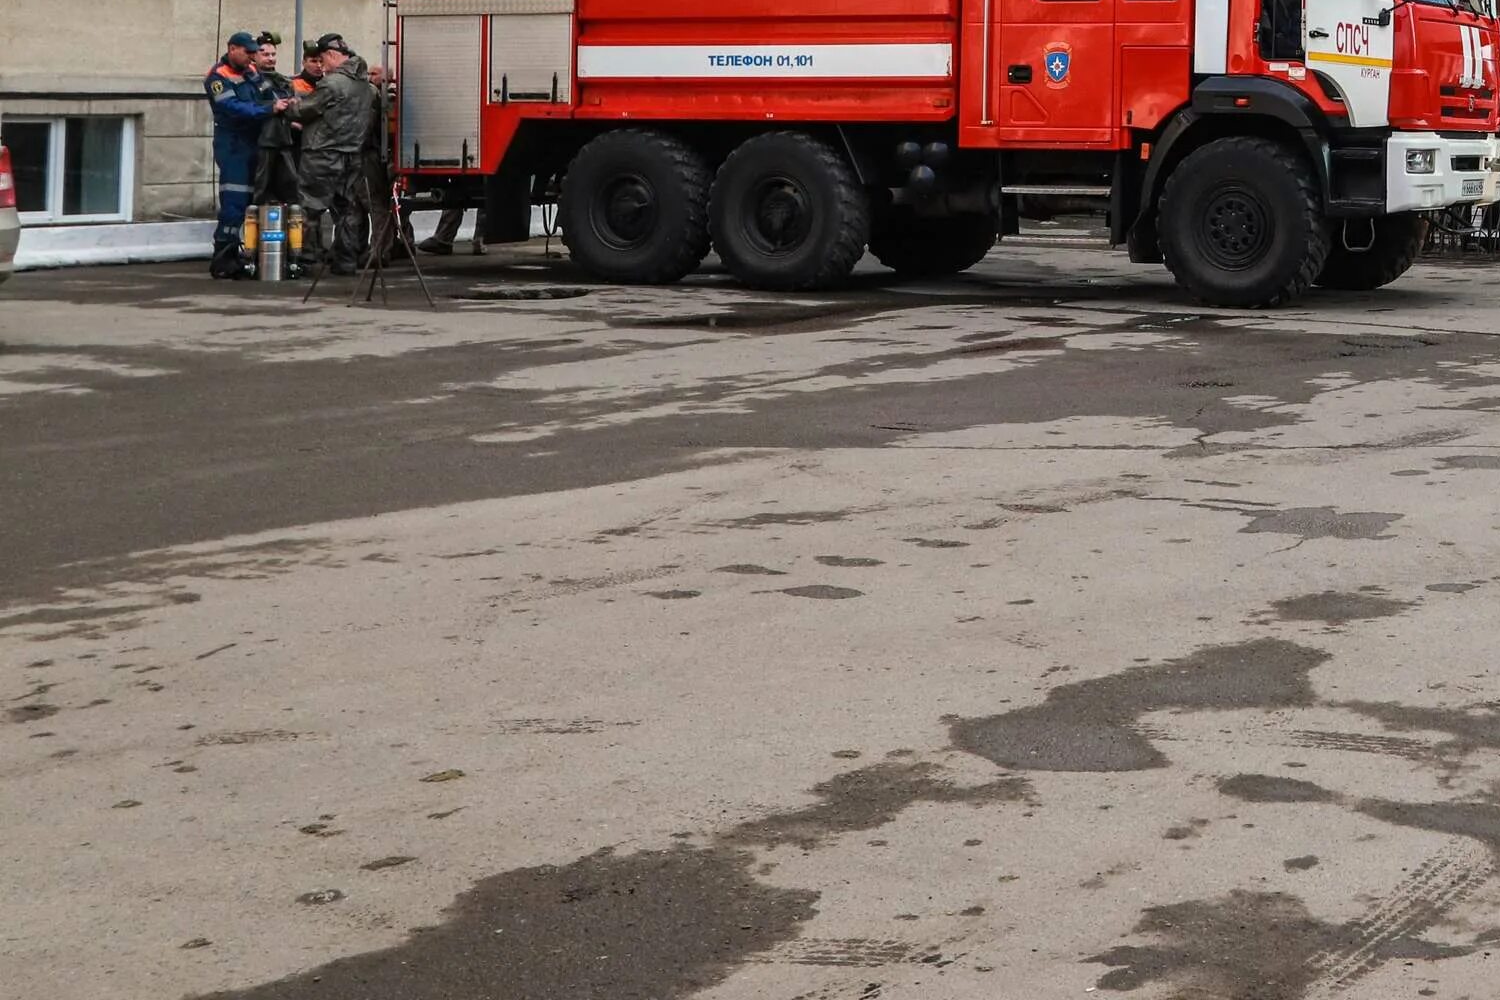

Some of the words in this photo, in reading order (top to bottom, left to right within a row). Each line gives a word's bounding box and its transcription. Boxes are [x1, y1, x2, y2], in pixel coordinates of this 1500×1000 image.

[1336, 22, 1369, 56] СПСЧ
[707, 55, 773, 67] ТЕЛЕФОН
[776, 55, 813, 68] 01,101
[1360, 67, 1381, 79] КУРГАН
